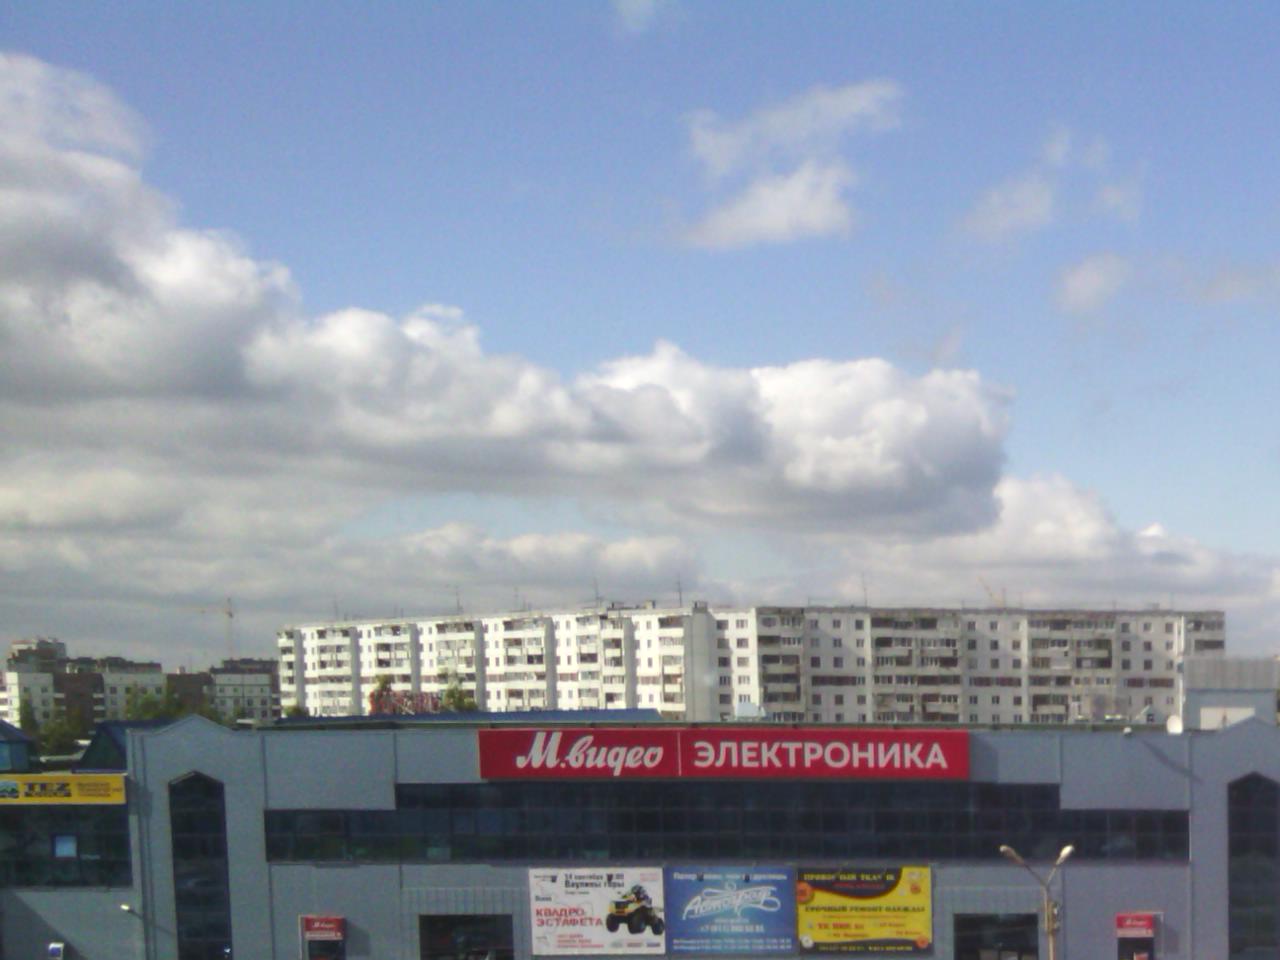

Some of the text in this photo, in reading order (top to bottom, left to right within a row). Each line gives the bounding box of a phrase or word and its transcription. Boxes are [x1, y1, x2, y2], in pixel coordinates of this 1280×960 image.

[516, 731, 949, 777] М.видео ЭЛЕКТРОНИКА
[536, 917, 603, 928] ЭСТАФЕТА
